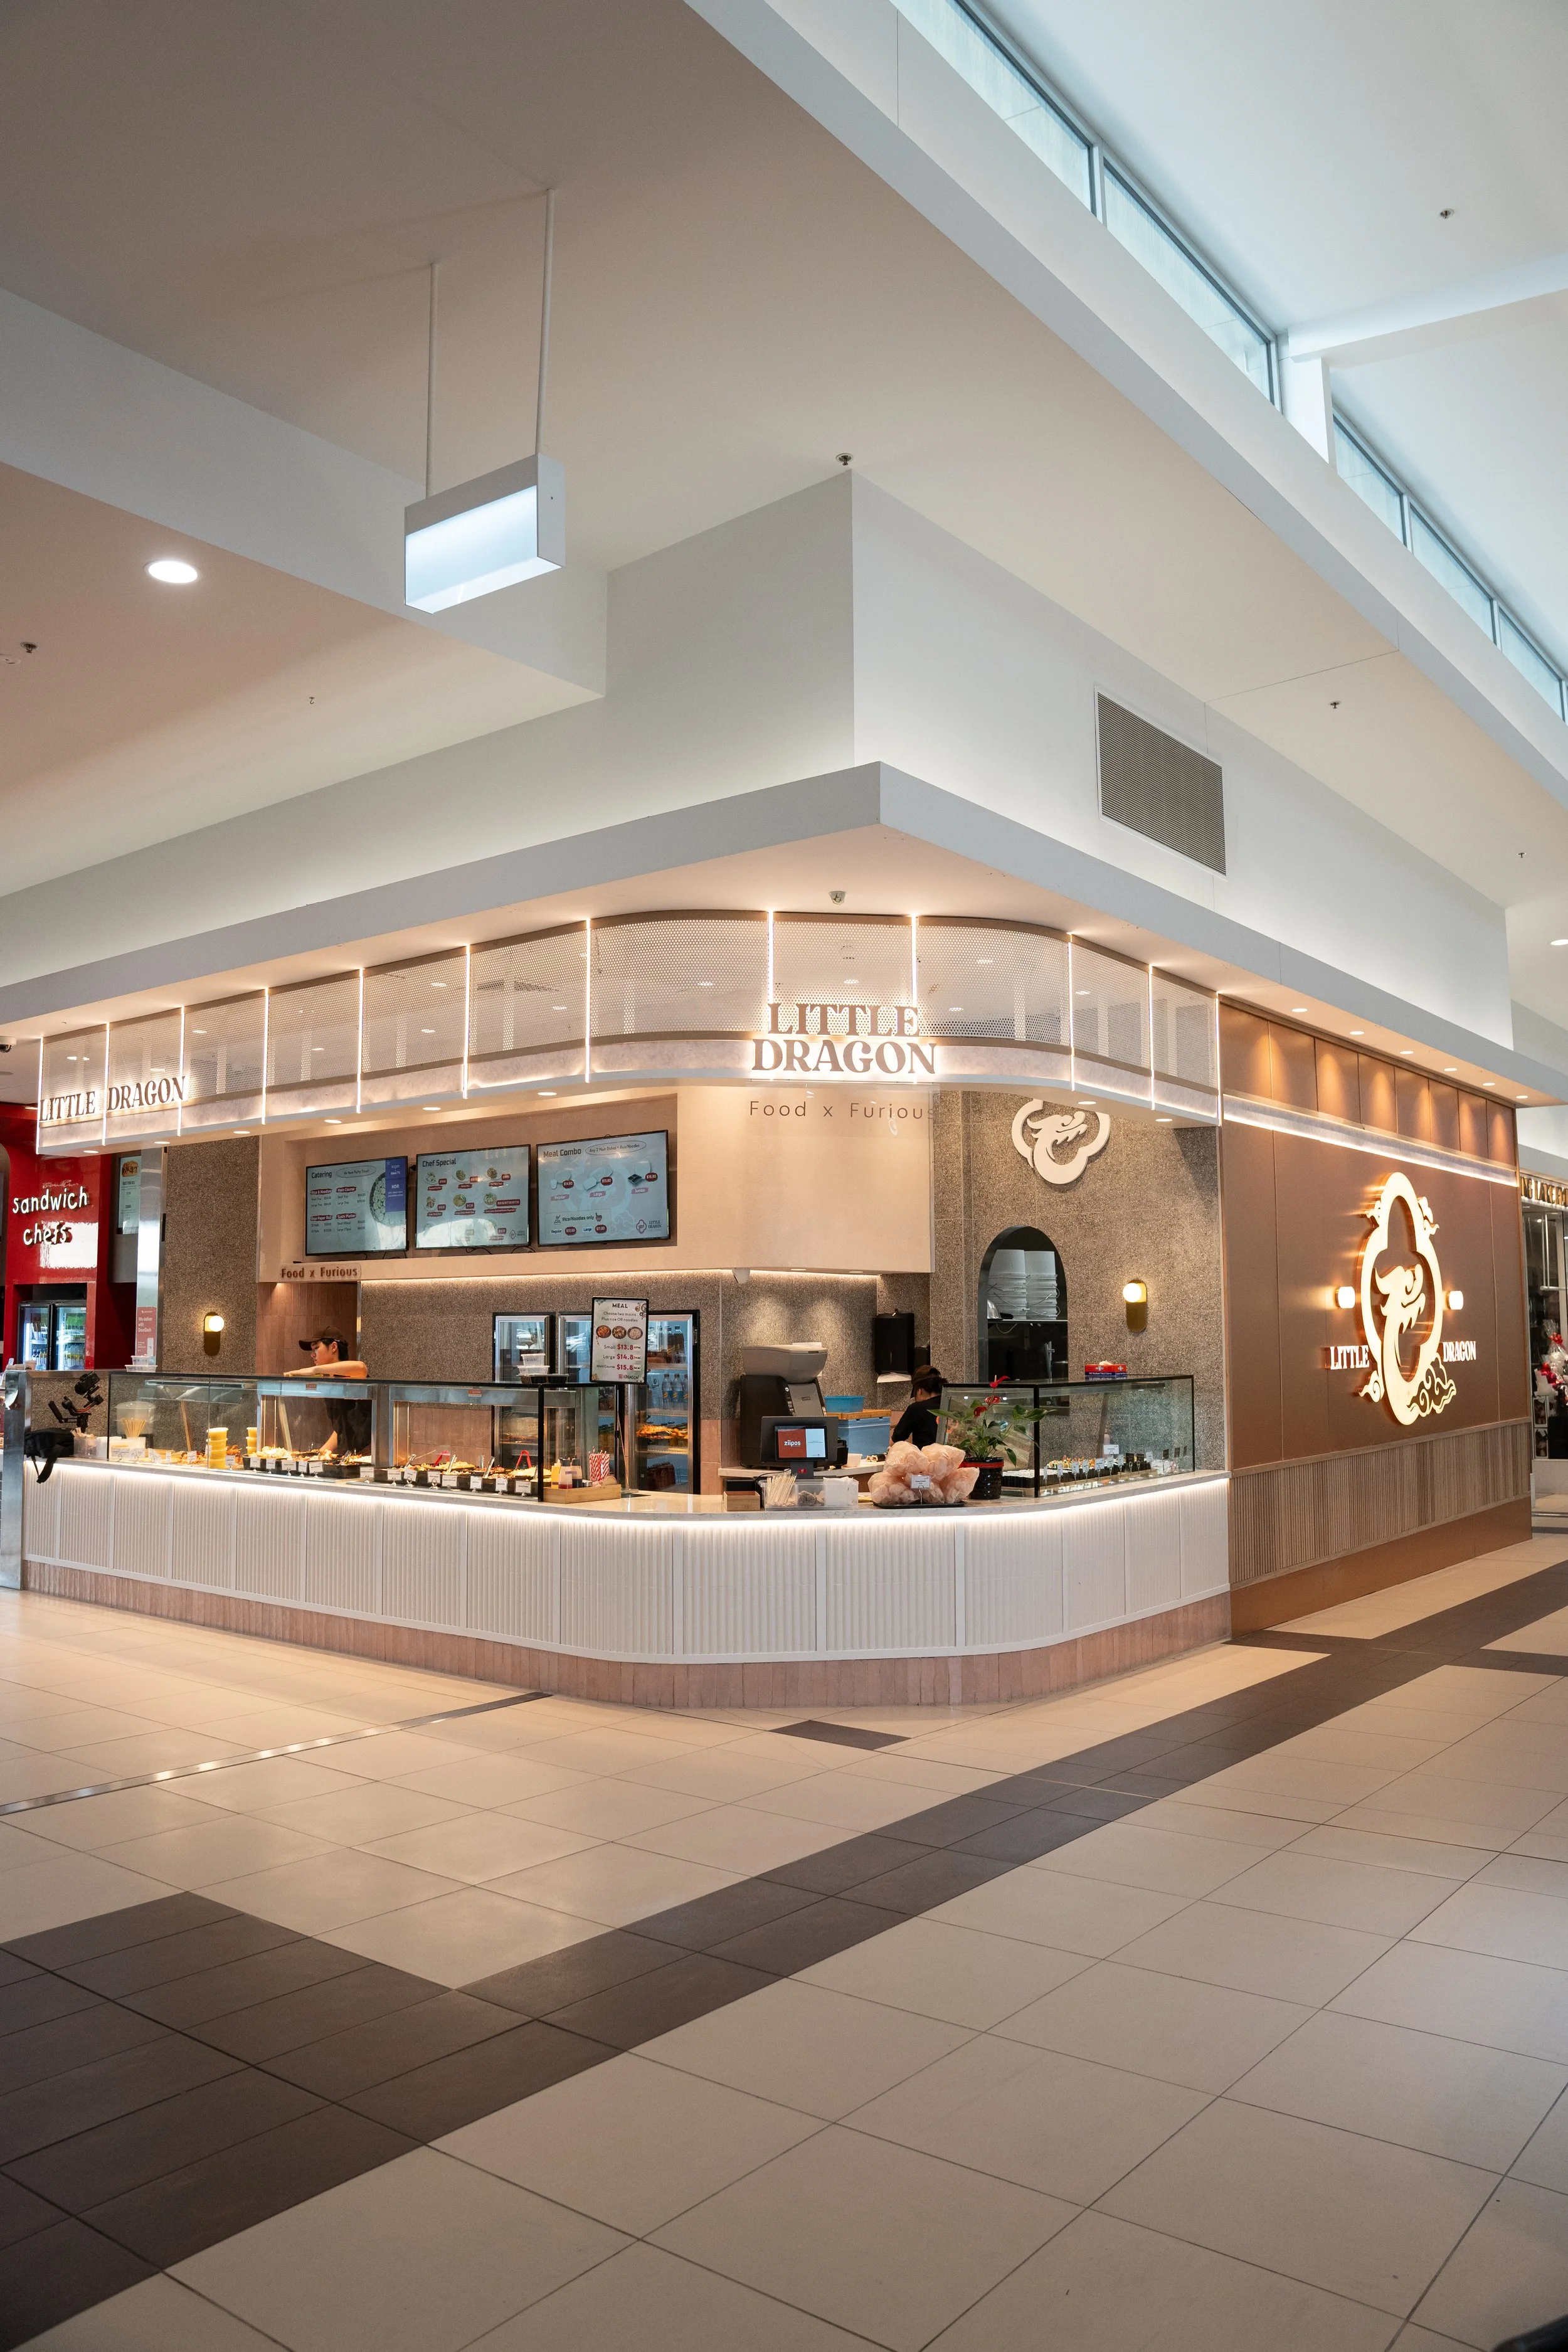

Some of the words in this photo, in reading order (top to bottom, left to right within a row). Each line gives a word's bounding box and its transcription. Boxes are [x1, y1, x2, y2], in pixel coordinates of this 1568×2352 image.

[768, 1004, 920, 1037] LITTLE
[752, 1039, 937, 1074] DRAGON
[40, 1091, 95, 1121] LITTLE
[107, 1076, 186, 1110] DRAGON
[750, 1101, 806, 1116] Food
[823, 1105, 833, 1116] x
[850, 1103, 933, 1120] Furious
[437, 1158, 456, 1167] Special
[13, 1186, 88, 1214] sandwich
[23, 1222, 68, 1246] chefs
[282, 1268, 304, 1278] Food
[320, 1266, 358, 1277] Furious
[1330, 1345, 1370, 1370] LITTLE
[1443, 1340, 1476, 1362] DRAGON
